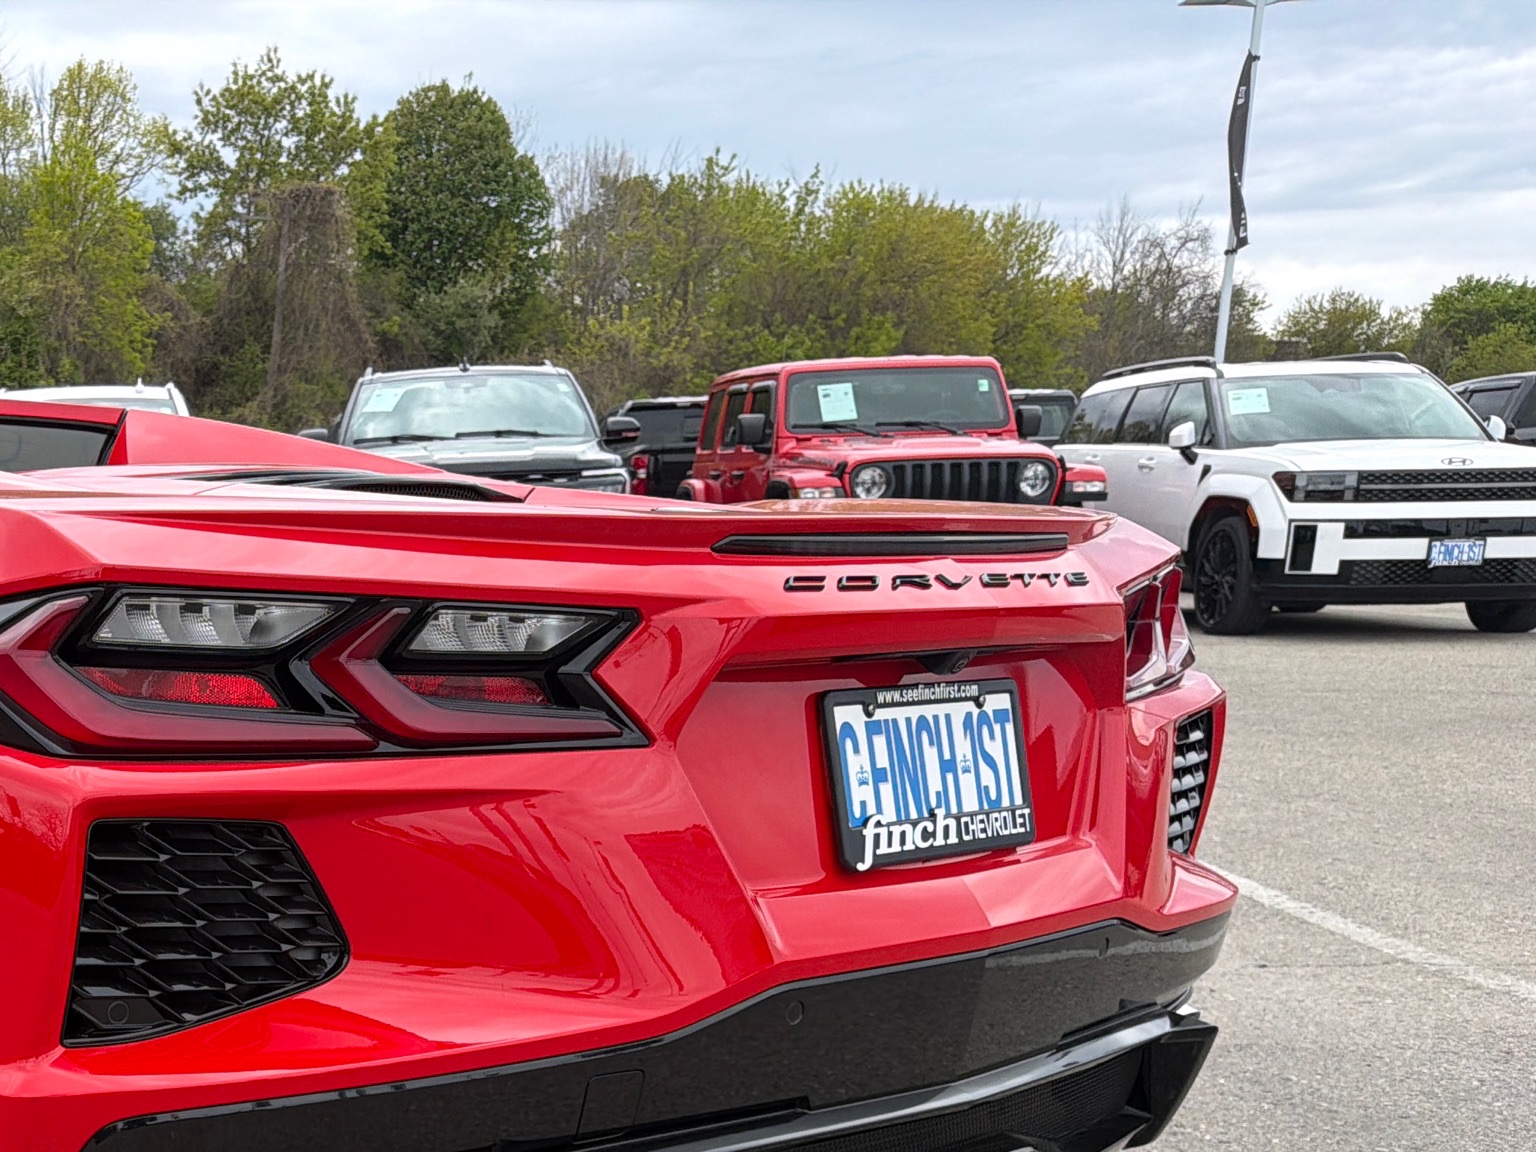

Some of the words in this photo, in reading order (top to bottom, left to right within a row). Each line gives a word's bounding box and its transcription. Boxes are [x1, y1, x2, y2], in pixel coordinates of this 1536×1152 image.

[783, 571, 1090, 593] CORVETTE
[876, 683, 979, 705] www.seefinchfirst.com
[864, 712, 964, 821] FINCH
[961, 708, 1020, 812] 1ST
[856, 808, 959, 872] finch
[960, 808, 1031, 842] CHEVROLET
